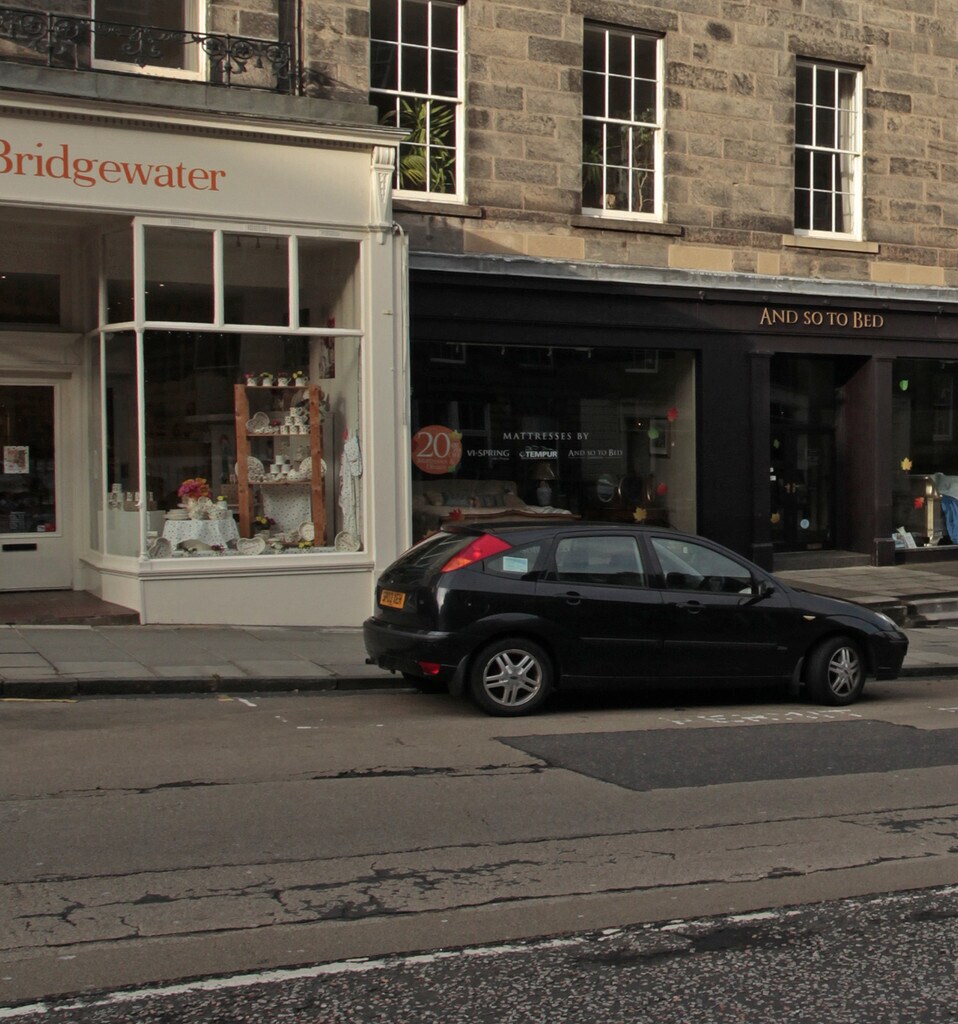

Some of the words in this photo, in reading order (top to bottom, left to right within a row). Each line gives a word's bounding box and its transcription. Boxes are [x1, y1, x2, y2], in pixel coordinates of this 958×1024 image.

[0, 139, 226, 191] Bridgewater
[503, 432, 572, 440] MATTRESSES
[577, 432, 590, 440] BY
[525, 450, 558, 458] TEMPUR
